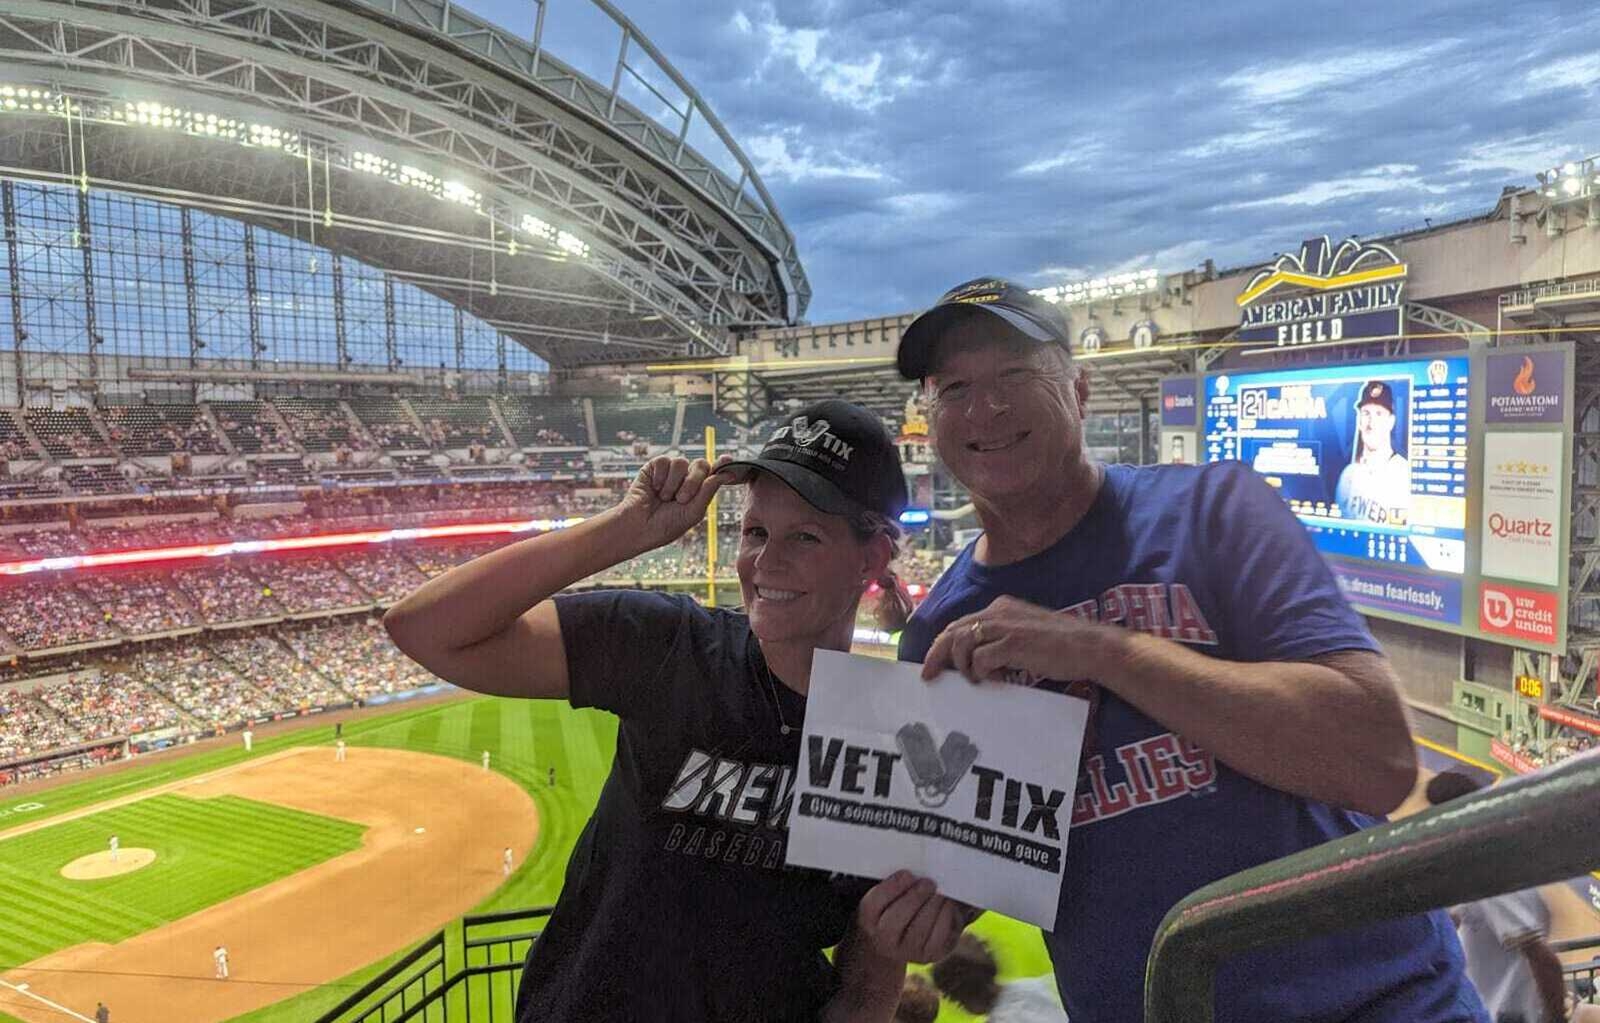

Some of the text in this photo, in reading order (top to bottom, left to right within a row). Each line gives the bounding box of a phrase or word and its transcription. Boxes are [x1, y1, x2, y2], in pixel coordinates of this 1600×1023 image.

[1240, 280, 1405, 328] AMERICAN FAMILY
[1277, 318, 1343, 346] FIELD
[1242, 389, 1267, 419] 21
[1491, 395, 1559, 407] POTAWATOMI
[823, 432, 855, 461] TIX
[1488, 513, 1552, 537] Quartz
[1386, 582, 1444, 610] fearlessly.
[1515, 597, 1535, 609] uw
[1515, 607, 1552, 624] credit
[1515, 619, 1552, 635] union
[807, 735, 1066, 841] VET TIX
[810, 797, 1049, 865] Give something to those who gave
